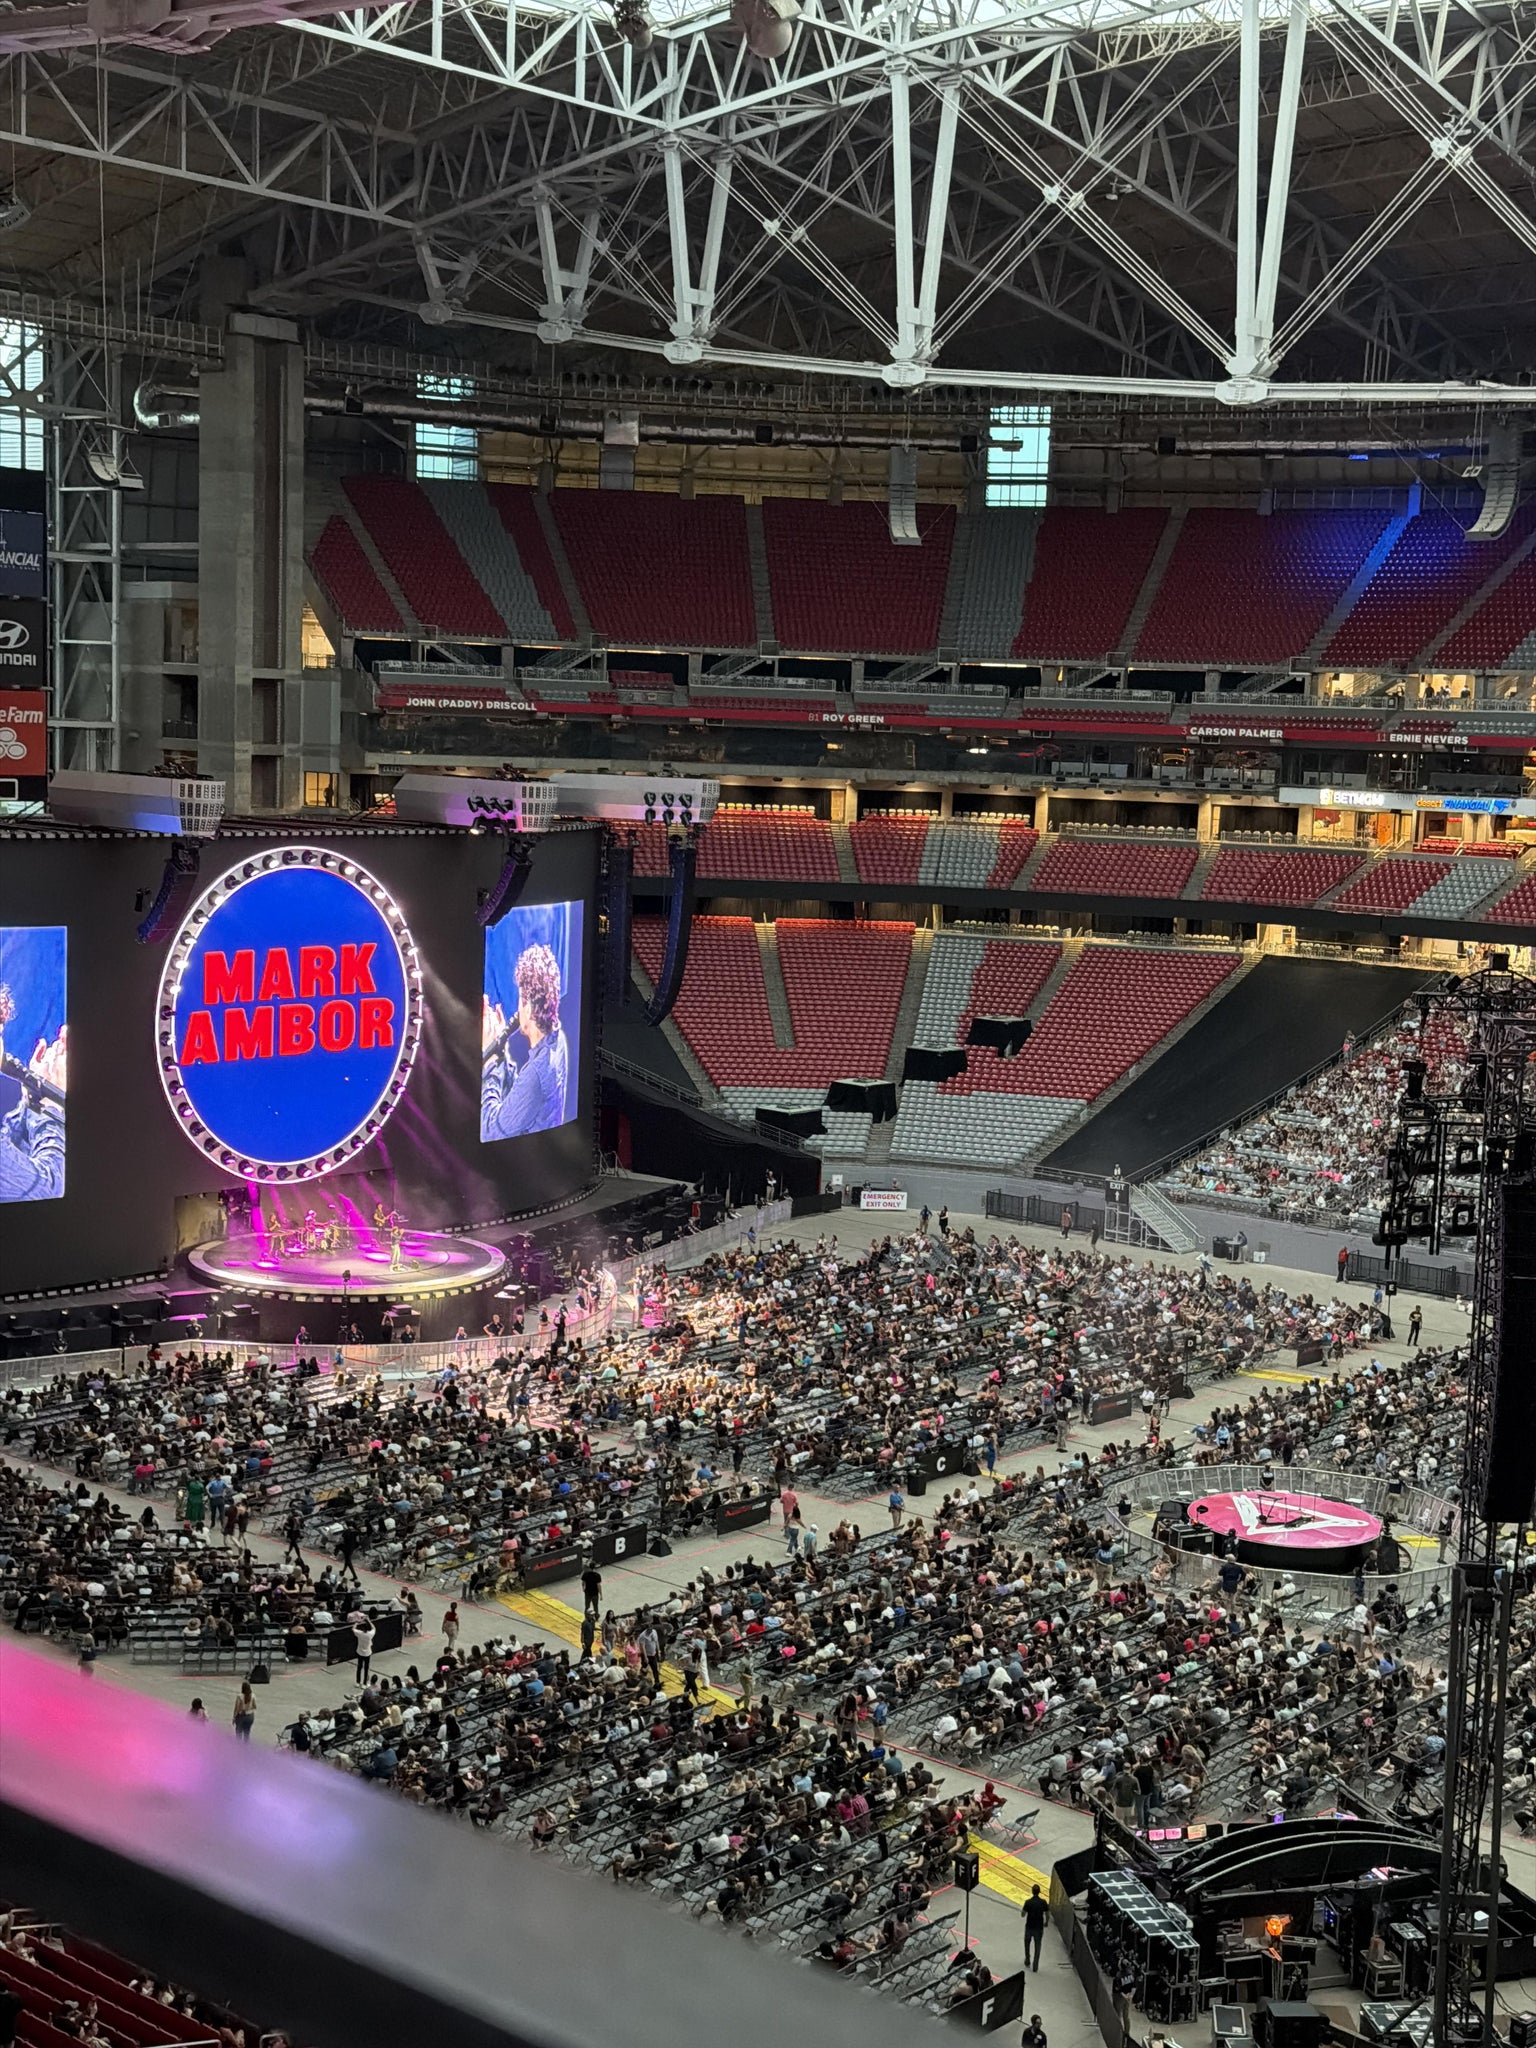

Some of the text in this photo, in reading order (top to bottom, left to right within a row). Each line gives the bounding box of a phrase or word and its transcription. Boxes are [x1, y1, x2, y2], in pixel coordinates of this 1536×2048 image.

[0, 653, 37, 666] NDAI
[406, 698, 537, 711] JOHN (PADDY) DRISCOLL
[808, 713, 884, 724] 81 ROY GREEN
[1181, 727, 1283, 738] 3 CARSON PALMER
[1376, 733, 1469, 745] 11 ERNIE NEVERS
[204, 943, 378, 1004] MARK
[180, 997, 395, 1066] AMBOR
[1109, 1182, 1125, 1190] EXIT
[936, 1456, 946, 1471] C
[665, 1481, 671, 1490] B
[615, 1537, 626, 1554] B
[260, 1595, 268, 1606] A
[959, 1864, 965, 1877] F
[981, 1997, 995, 2026] F
